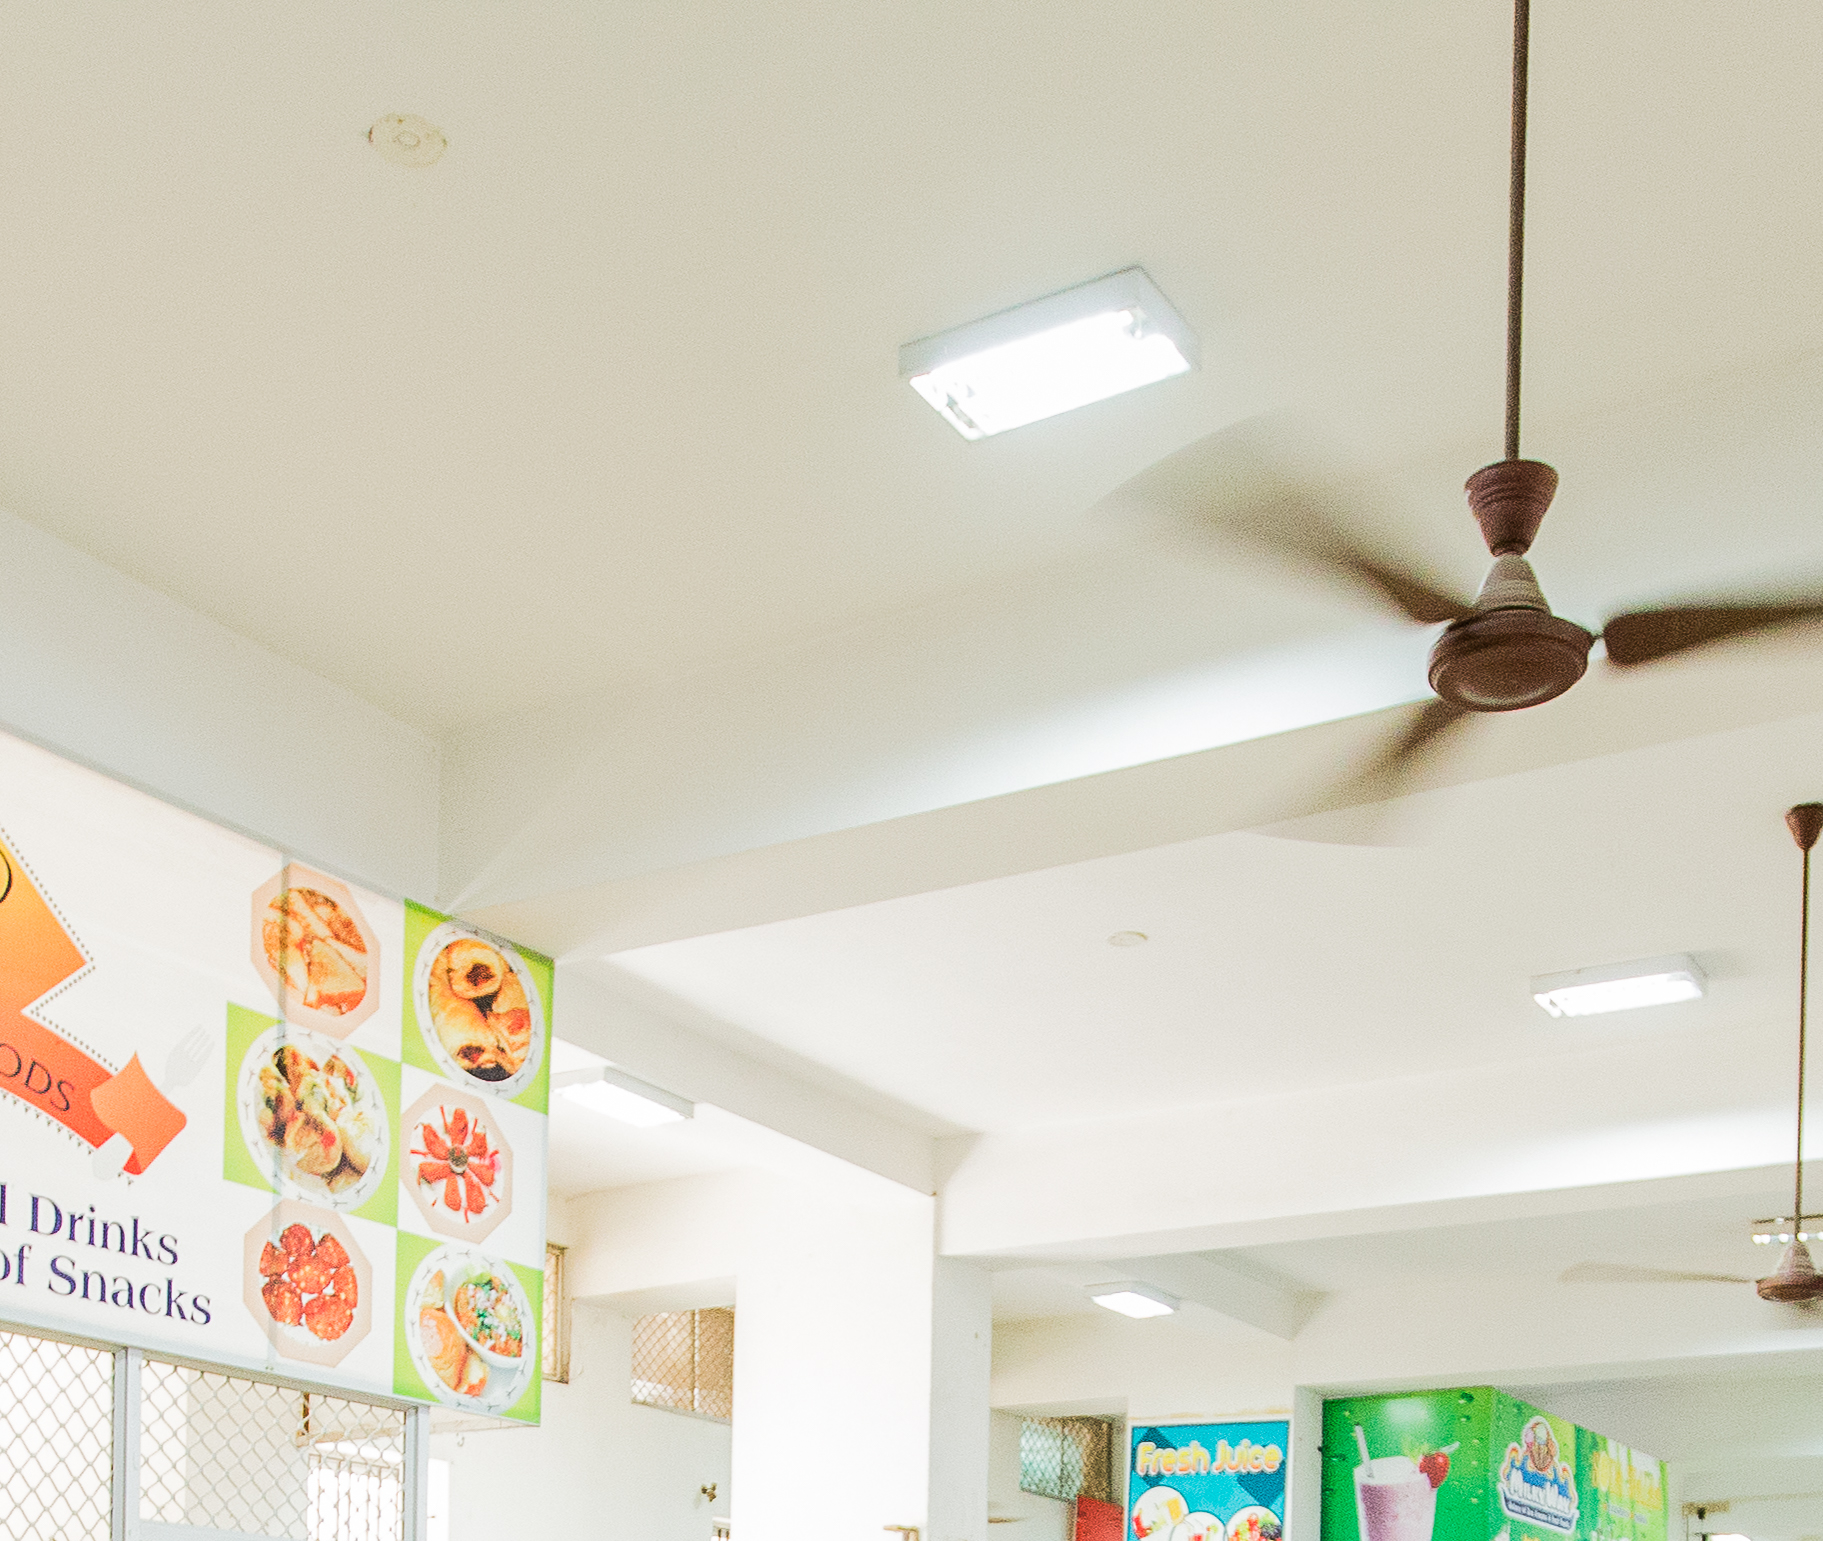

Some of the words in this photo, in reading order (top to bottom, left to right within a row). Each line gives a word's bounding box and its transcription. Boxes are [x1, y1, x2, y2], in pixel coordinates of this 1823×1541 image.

[31, 1192, 179, 1267] Drinks
[47, 1254, 213, 1327] Snacks
[1136, 1440, 1211, 1476] Fresh
[1212, 1438, 1282, 1474] Juice
